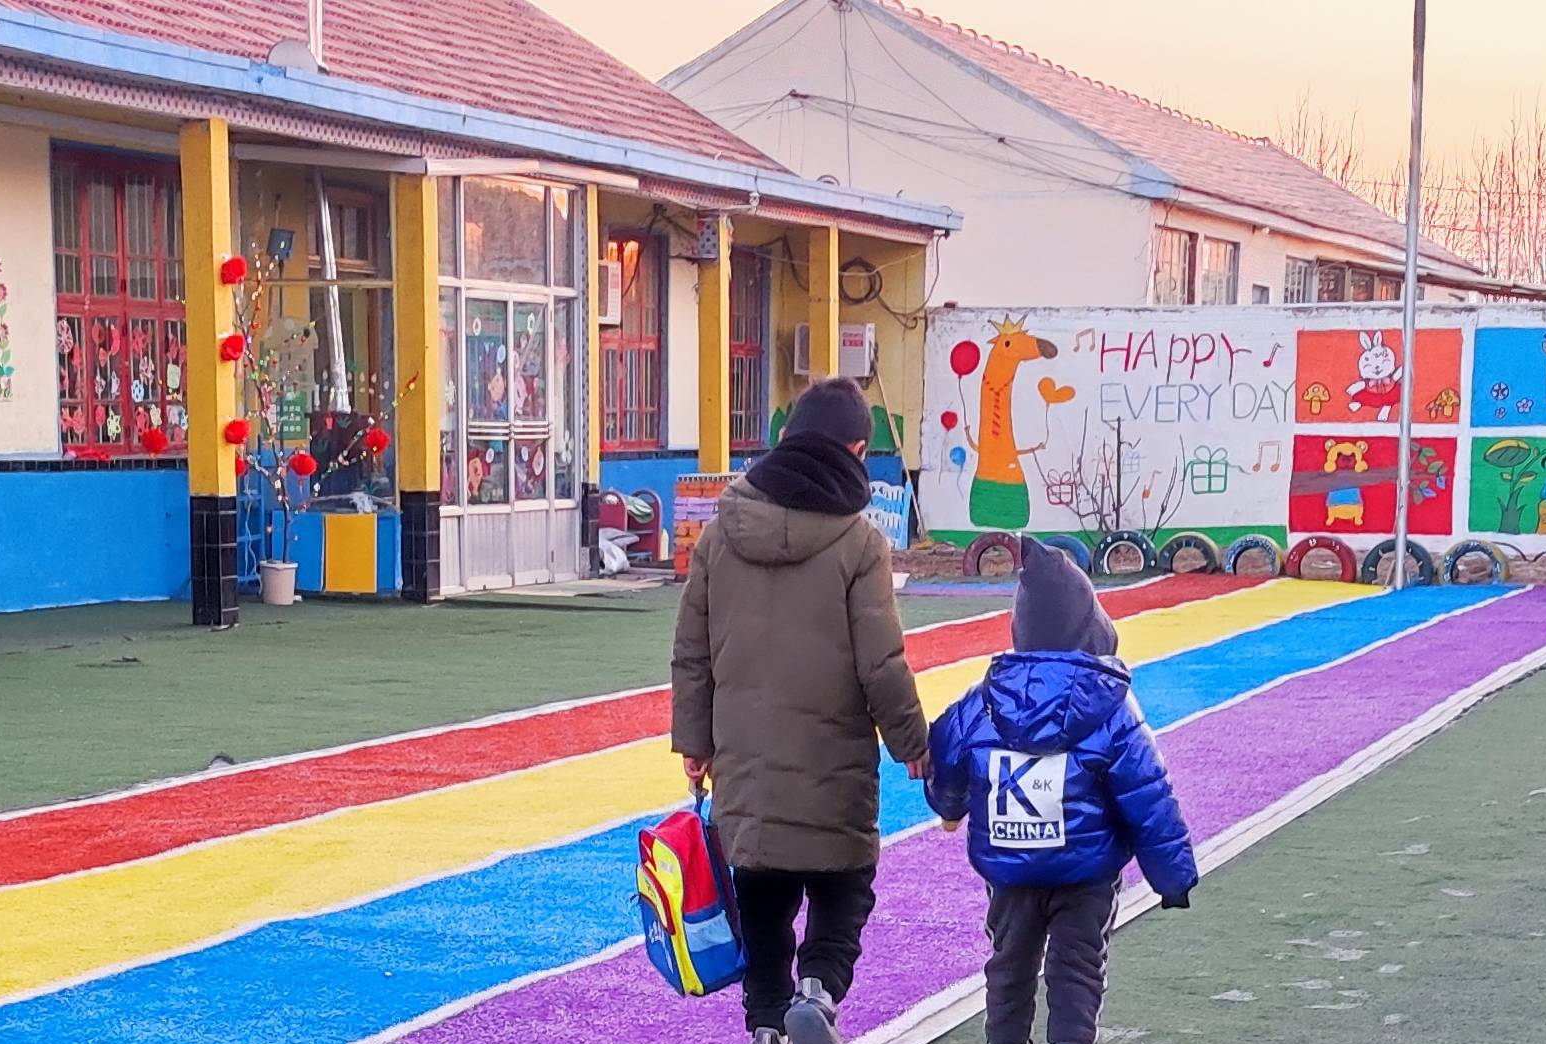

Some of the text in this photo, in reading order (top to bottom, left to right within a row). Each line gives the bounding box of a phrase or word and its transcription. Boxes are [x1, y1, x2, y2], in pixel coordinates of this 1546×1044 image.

[1101, 329, 1252, 384] HAPPY
[1100, 380, 1297, 424] EVERY DAY
[996, 756, 1043, 818] K
[993, 822, 1058, 839] CHINA
